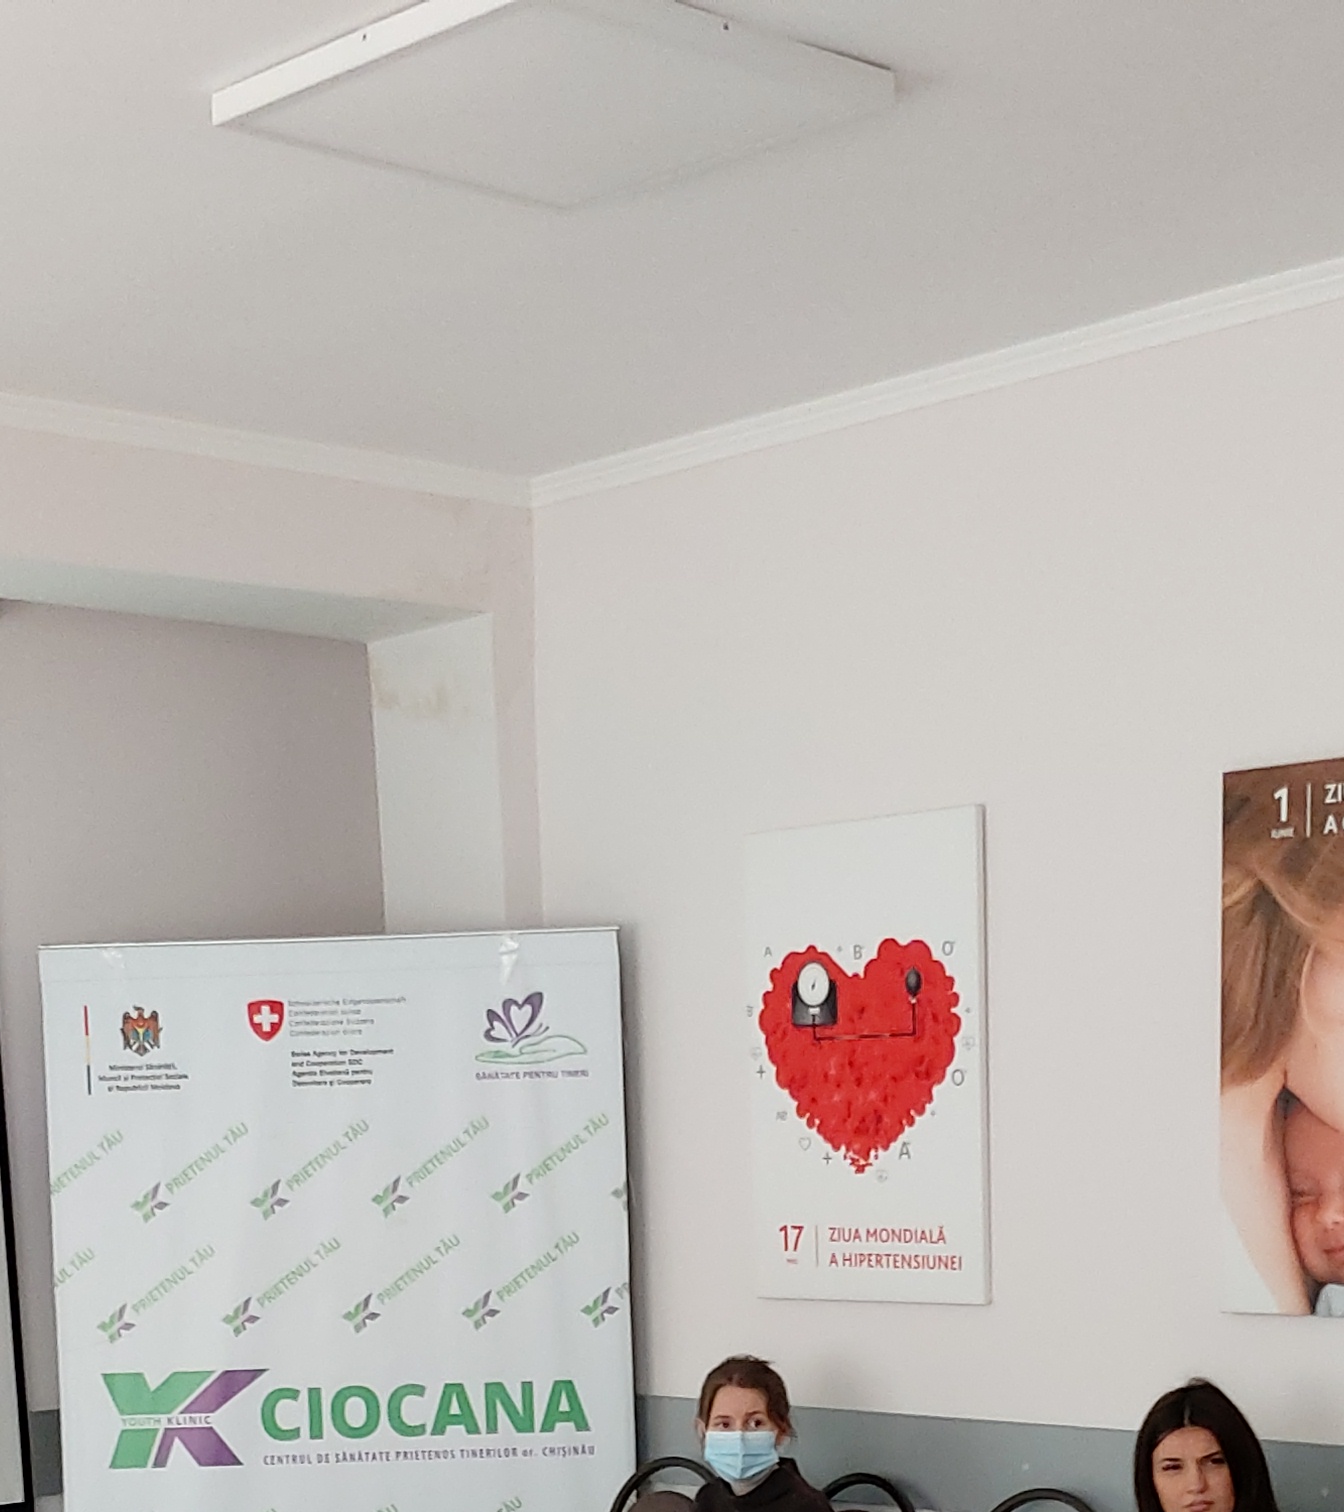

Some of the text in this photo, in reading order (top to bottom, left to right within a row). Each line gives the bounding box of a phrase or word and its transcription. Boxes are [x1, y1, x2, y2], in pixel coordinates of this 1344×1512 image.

[1273, 786, 1289, 823] 1
[1323, 814, 1338, 835] A
[165, 1143, 225, 1195] PRIETENUL
[285, 1140, 347, 1192] PRIETENUL
[406, 1137, 466, 1188] PRIETENUL
[526, 1134, 586, 1185] PRIETENUL
[778, 1224, 805, 1252] 17
[828, 1226, 947, 1245] ZIUA MONDIALĂ
[256, 1257, 318, 1309] PRIETENUL
[376, 1253, 438, 1305] PRIETENUL
[496, 1252, 557, 1303] PRIETENUL
[829, 1253, 962, 1271] A HIPERTENSIUNEI
[132, 1266, 193, 1315] PRIETENUL
[166, 1415, 212, 1426] KLINIC
[260, 1379, 591, 1441] CIOCANA
[263, 1453, 313, 1466] CENTRUL
[317, 1452, 331, 1464] DE
[395, 1448, 456, 1461] PRIETENOS
[460, 1447, 518, 1460] TINERILOR
